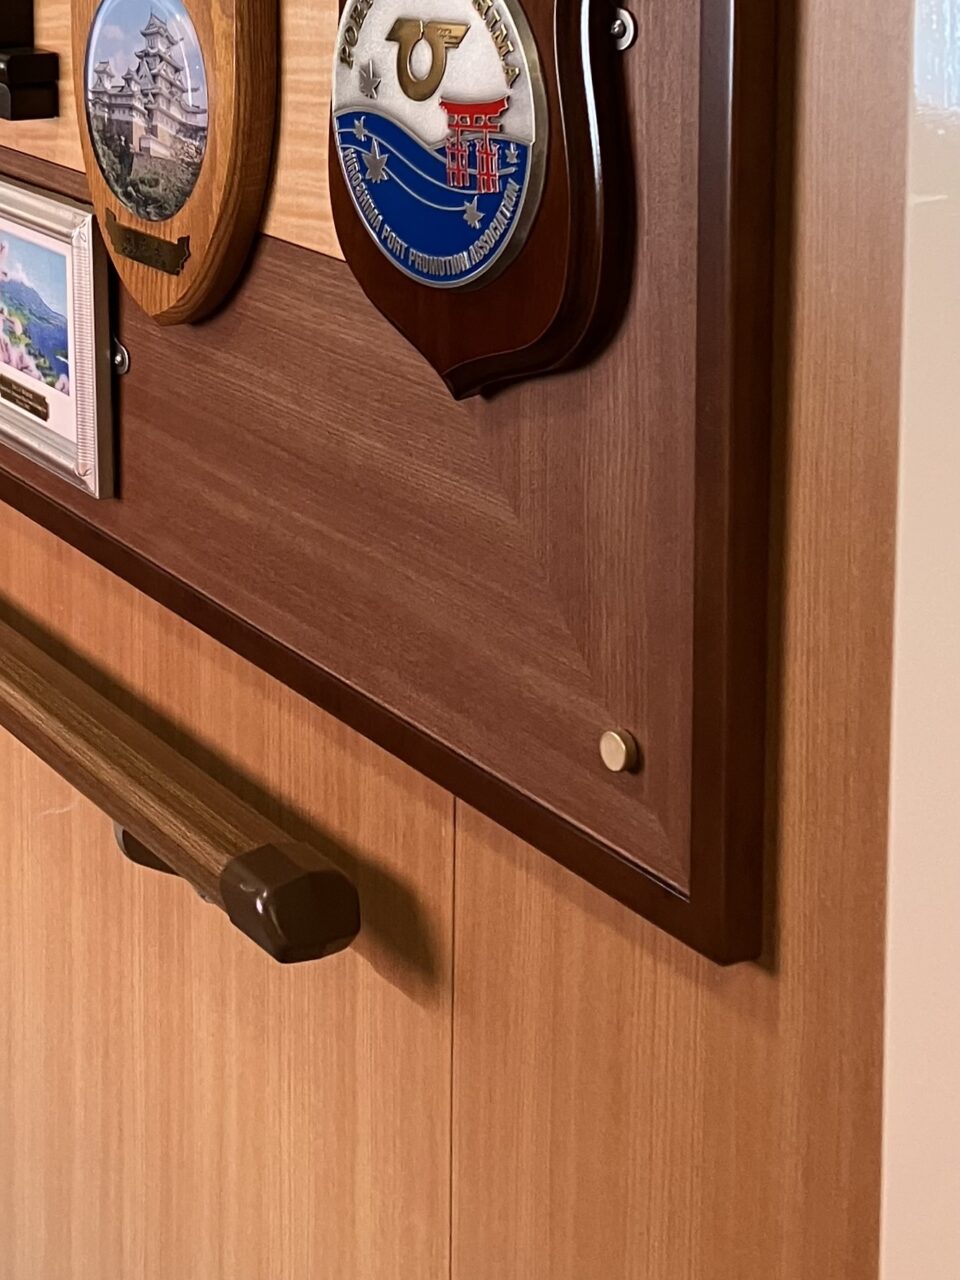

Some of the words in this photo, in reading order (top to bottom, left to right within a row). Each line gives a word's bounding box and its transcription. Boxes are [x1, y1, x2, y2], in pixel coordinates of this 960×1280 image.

[343, 147, 383, 236] HIROSHIMA
[380, 223, 407, 261] PORT
[408, 245, 470, 278] PROMOTION
[468, 179, 520, 267] ASSOCIATION
